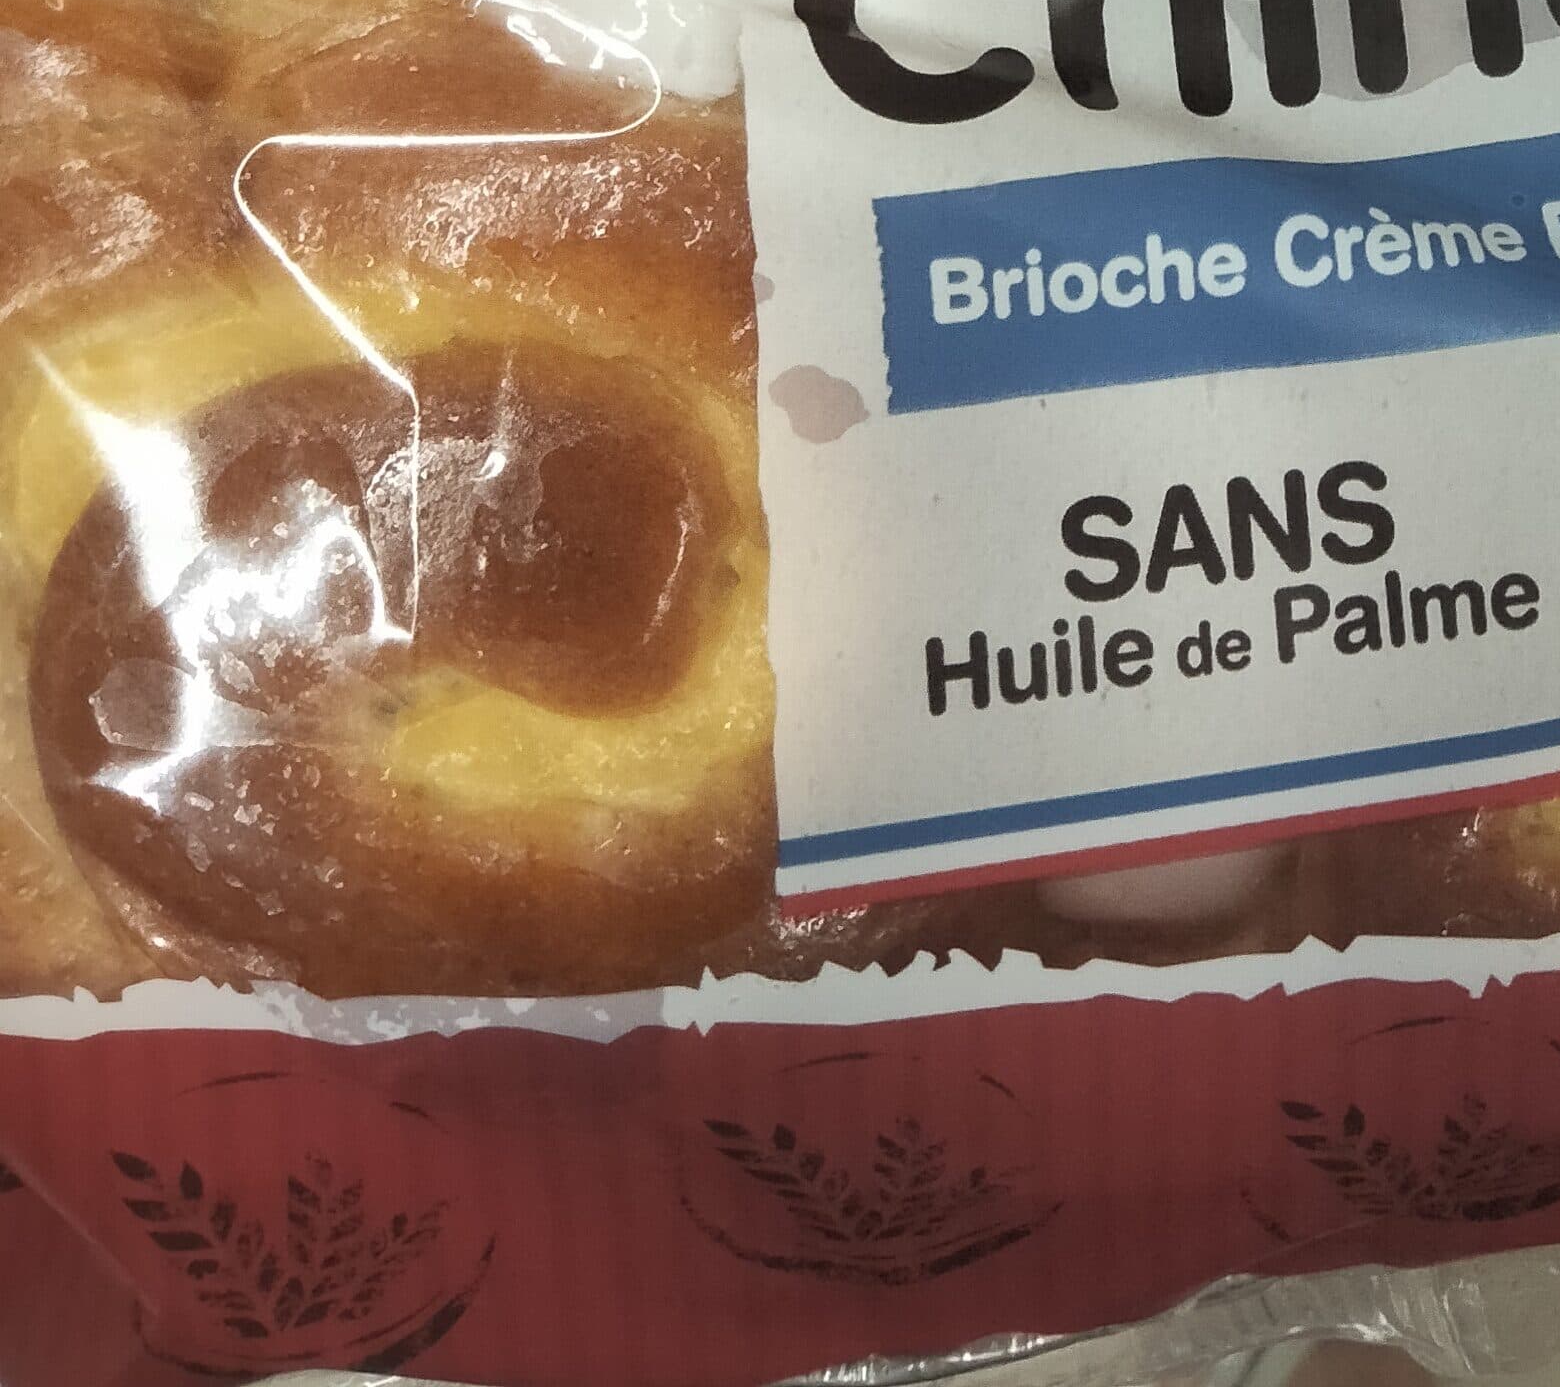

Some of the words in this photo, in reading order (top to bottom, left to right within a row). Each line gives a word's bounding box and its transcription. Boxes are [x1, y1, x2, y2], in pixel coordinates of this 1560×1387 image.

[928, 229, 1246, 326] Brioche
[1274, 207, 1528, 290] Crème
[1059, 460, 1398, 604] SANS
[925, 613, 1156, 717] Huile
[1175, 619, 1253, 677] de
[1274, 569, 1542, 666] Palme
